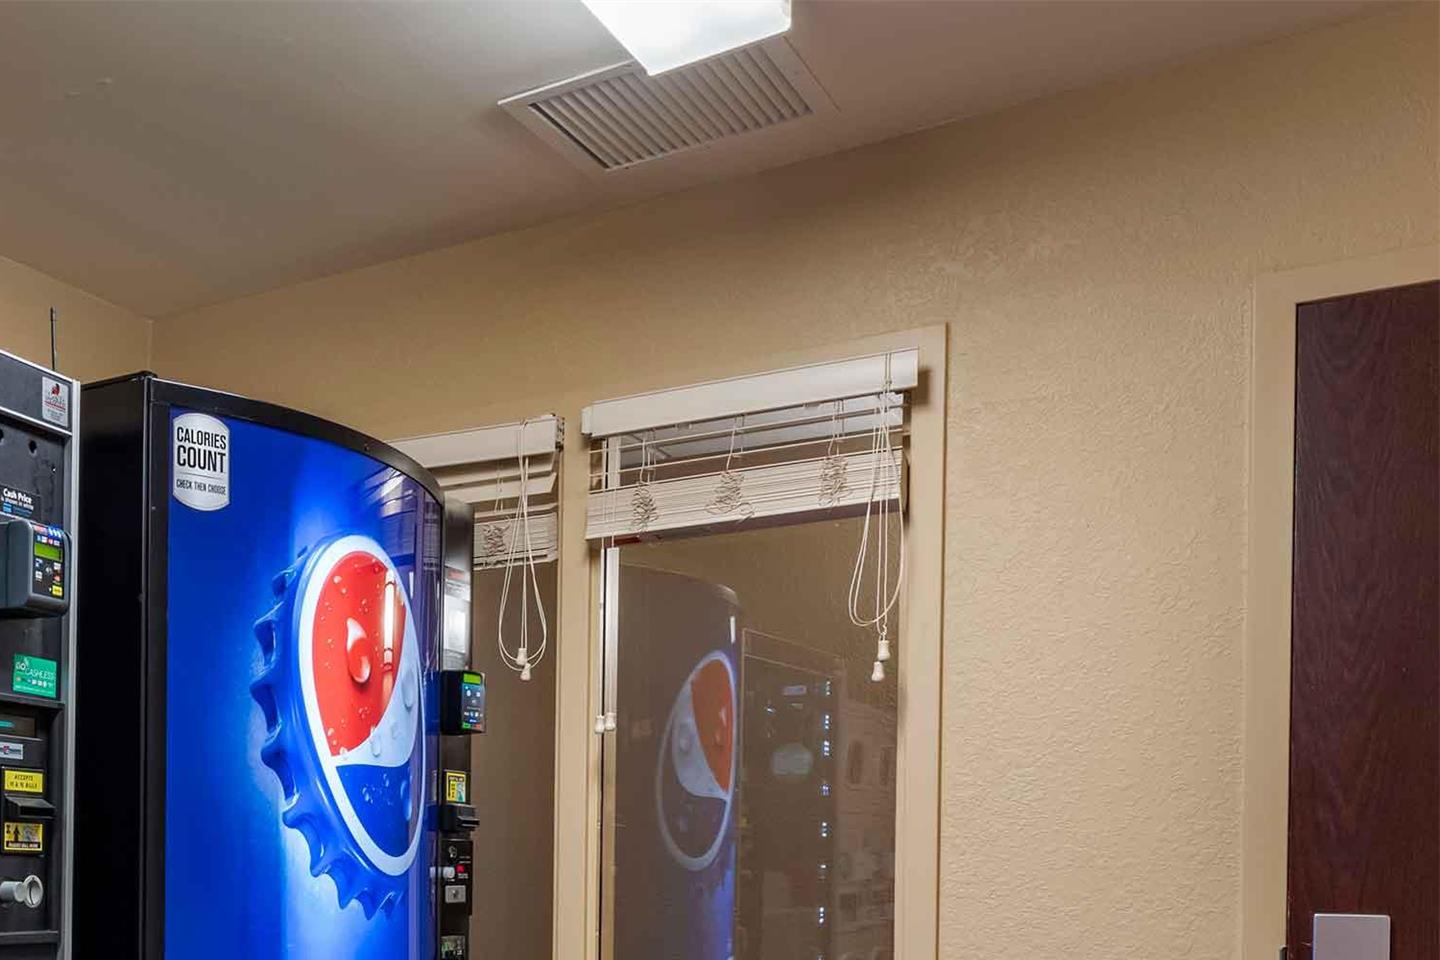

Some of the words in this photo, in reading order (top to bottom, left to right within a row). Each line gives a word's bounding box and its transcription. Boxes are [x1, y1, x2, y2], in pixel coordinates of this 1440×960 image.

[176, 426, 227, 450] CALORIES
[177, 444, 226, 473] COUNT
[3, 488, 18, 500] Cash
[17, 492, 32, 505] Price
[176, 478, 193, 490] CHECK
[194, 481, 207, 492] THEN
[207, 483, 227, 496] CHOOSE
